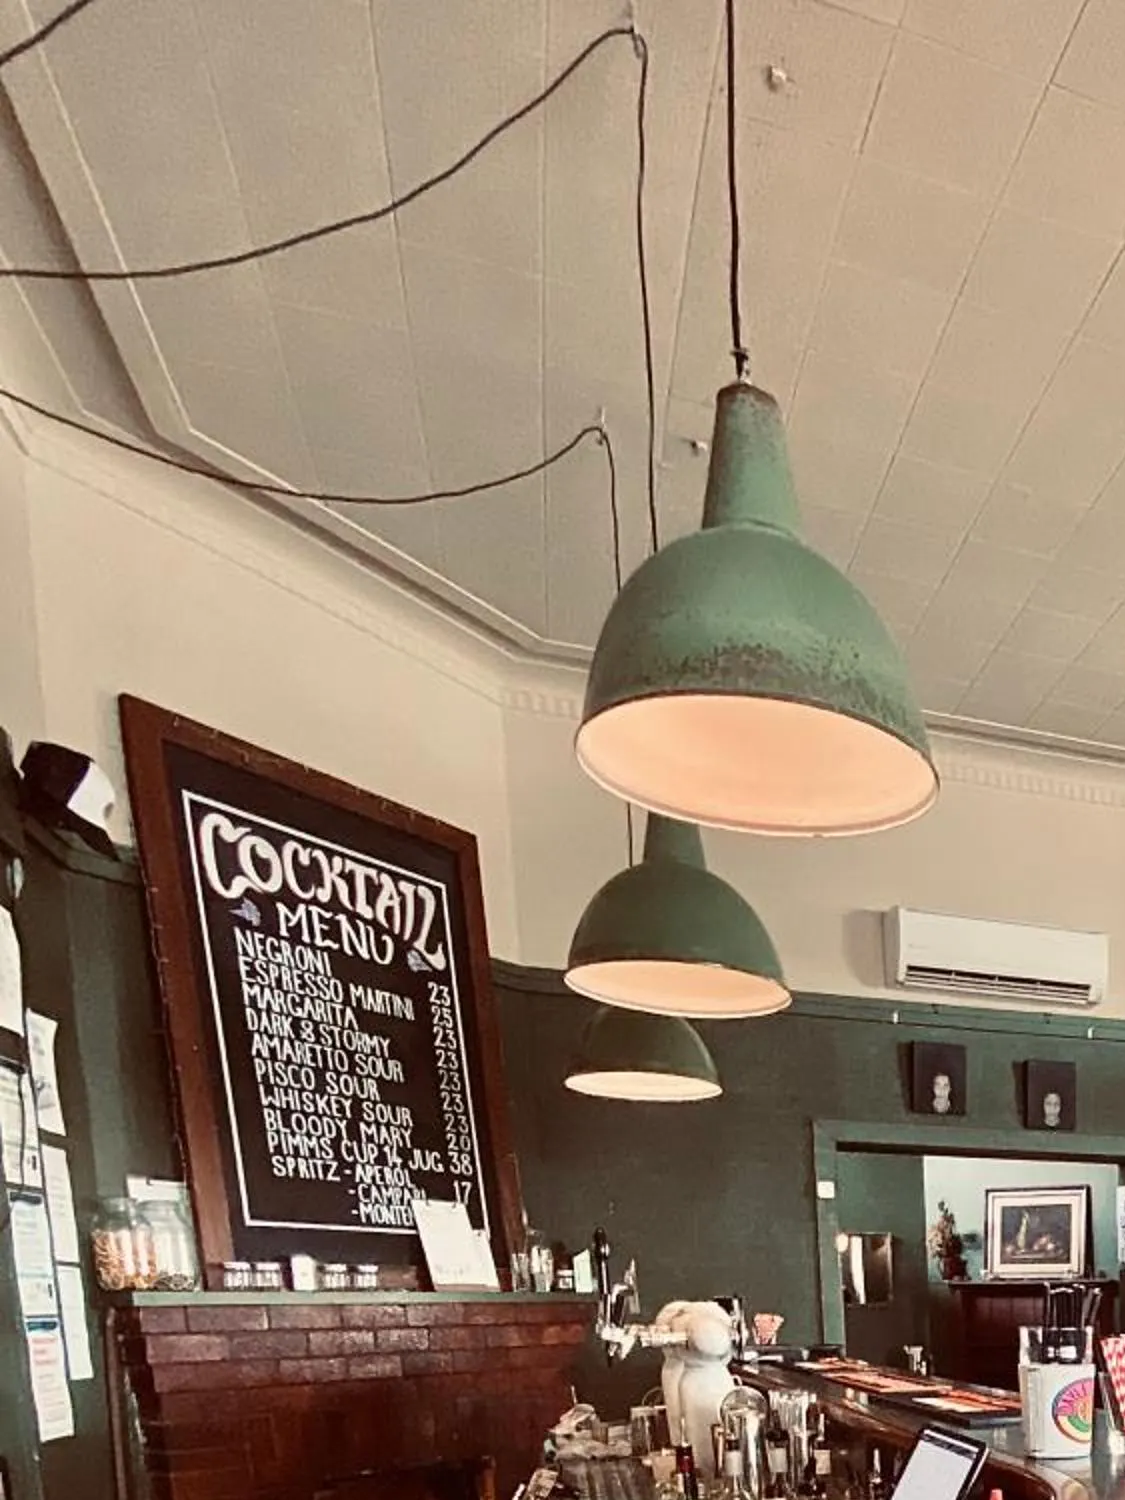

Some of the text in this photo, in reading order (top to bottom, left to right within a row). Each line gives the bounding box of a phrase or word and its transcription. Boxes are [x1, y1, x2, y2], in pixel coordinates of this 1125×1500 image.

[200, 813, 446, 971] COCKTAIL
[276, 902, 394, 965] MENU
[234, 926, 451, 1006] NEGRONI 23
[239, 956, 453, 1028] ESPRESSO MARTINI 25
[242, 981, 457, 1050] MARGARITA 23
[246, 1007, 296, 1039] DARK
[320, 1023, 390, 1058] STORMY
[436, 1049, 459, 1070] 23
[251, 1032, 461, 1091] AMARETTO SOUR 23
[255, 1057, 465, 1113] PISCO SOUR 23
[258, 1083, 469, 1134] WHISKEY SOUR 23
[263, 1107, 471, 1152] BLOODY MARY 20
[267, 1131, 334, 1159] PIMMS
[341, 1140, 379, 1164] CUP
[408, 1148, 444, 1173] JUG
[448, 1151, 473, 1175] 38
[271, 1155, 341, 1181] SPRITZ
[453, 1180, 472, 1206] 17
